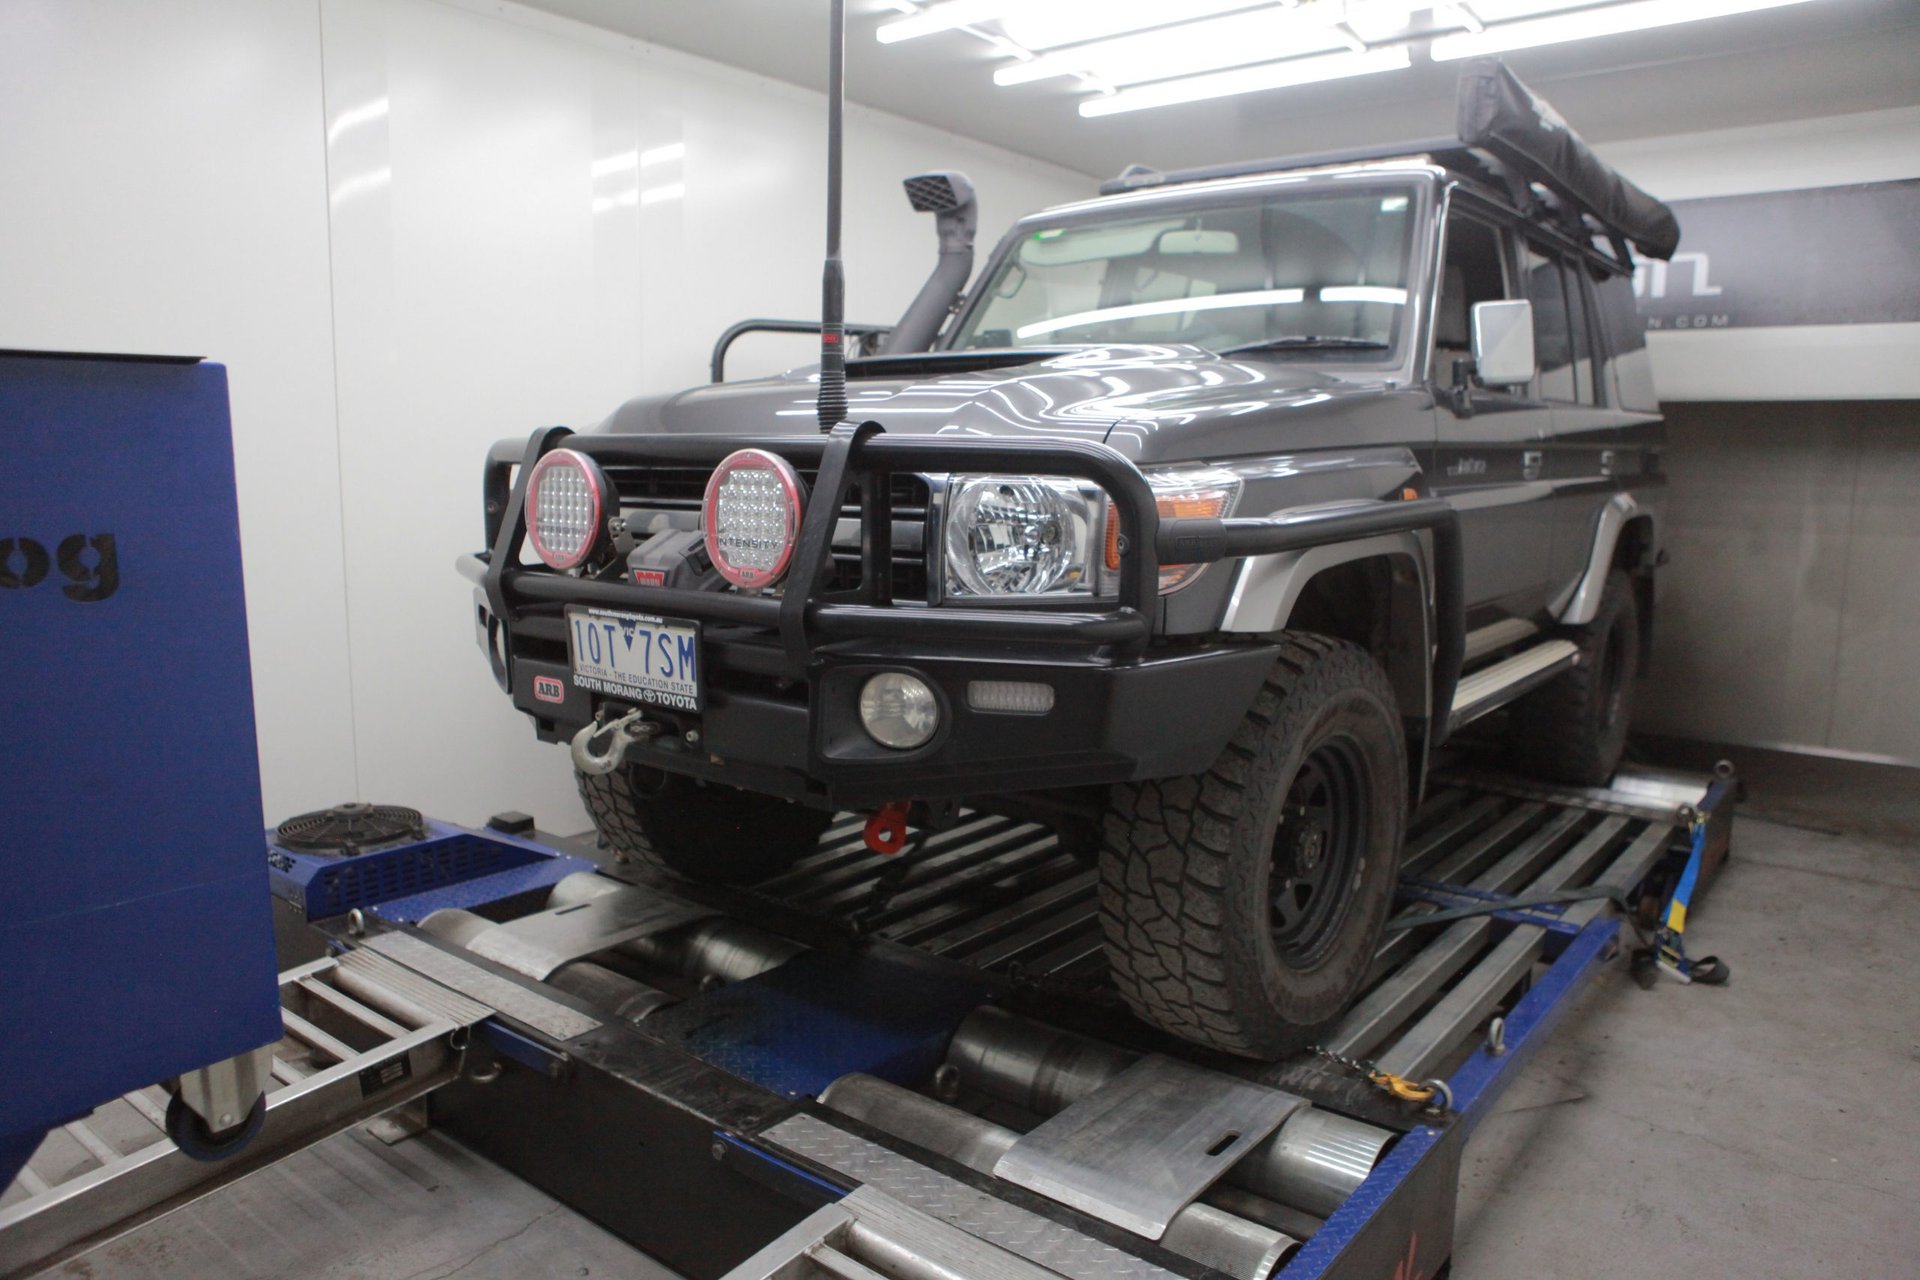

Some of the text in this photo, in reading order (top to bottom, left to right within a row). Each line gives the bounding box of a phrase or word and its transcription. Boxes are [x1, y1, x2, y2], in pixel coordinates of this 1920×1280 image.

[639, 629, 697, 682] 7SM
[538, 681, 560, 698] ARB
[573, 674, 698, 711] SOUTH MORANG TOYOTA
[579, 662, 608, 677] VICTORIA
[614, 671, 627, 681] THE
[628, 673, 670, 690] EDUCATION
[671, 682, 694, 694] STATE
